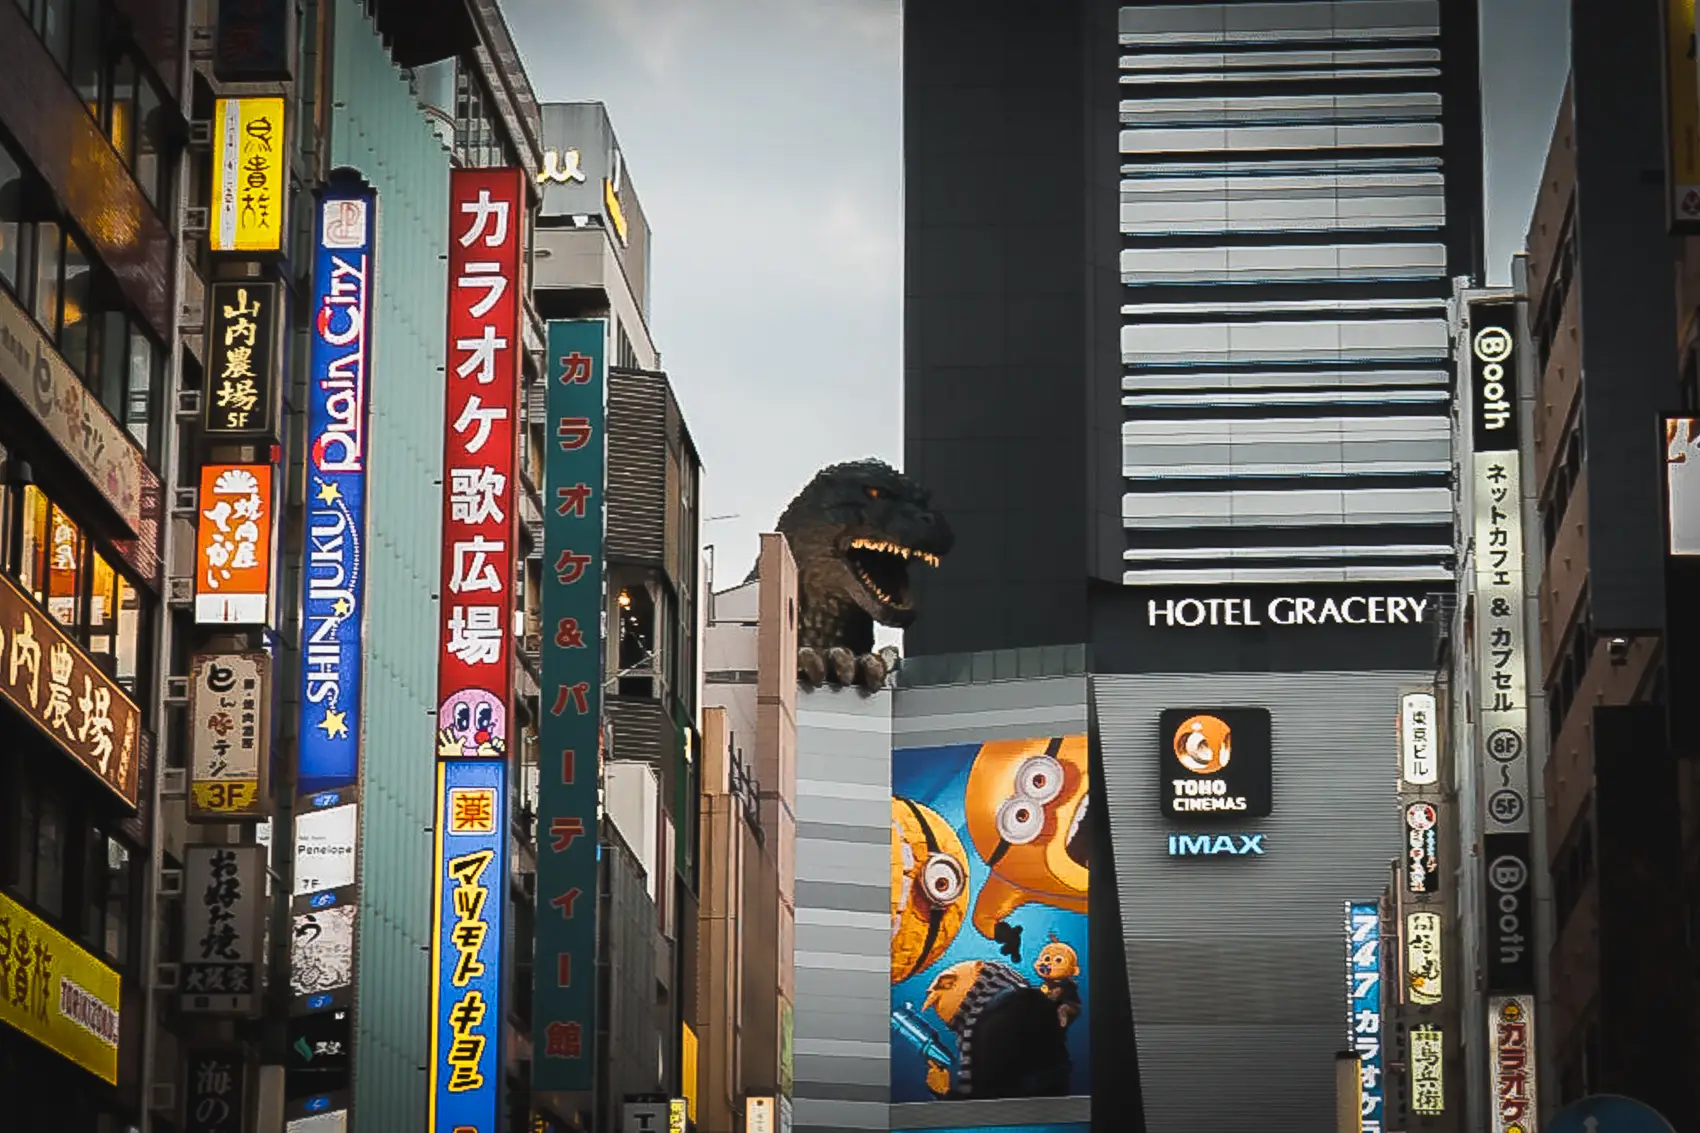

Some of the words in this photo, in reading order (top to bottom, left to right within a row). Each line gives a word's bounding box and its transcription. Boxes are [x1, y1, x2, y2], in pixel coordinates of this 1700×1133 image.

[216, 288, 260, 411] 山内農場
[1474, 326, 1513, 431] Booth
[447, 190, 509, 666] カラオケ歌広場
[1486, 464, 1511, 586] ネットカフェ
[307, 510, 356, 704] SHINJUKU
[1148, 598, 1261, 627] HOTEL
[1267, 596, 1427, 625] GRACERY
[1490, 598, 1510, 618] &
[0, 611, 114, 775] 内農場
[545, 352, 593, 1058] カラオケ&パーティー館
[1490, 627, 1514, 713] カプセル
[207, 783, 246, 809] 3F
[455, 793, 492, 829] 薬
[1172, 779, 1227, 796] TOHO
[1172, 797, 1248, 811] CINEMAS
[1168, 833, 1265, 856] IMAX
[1352, 915, 1380, 998] 747
[1489, 855, 1528, 965] Booth
[448, 848, 494, 1091] マツモトキヨシ
[195, 1059, 233, 1133] 海の
[1498, 1022, 1530, 1123] カラオケ
